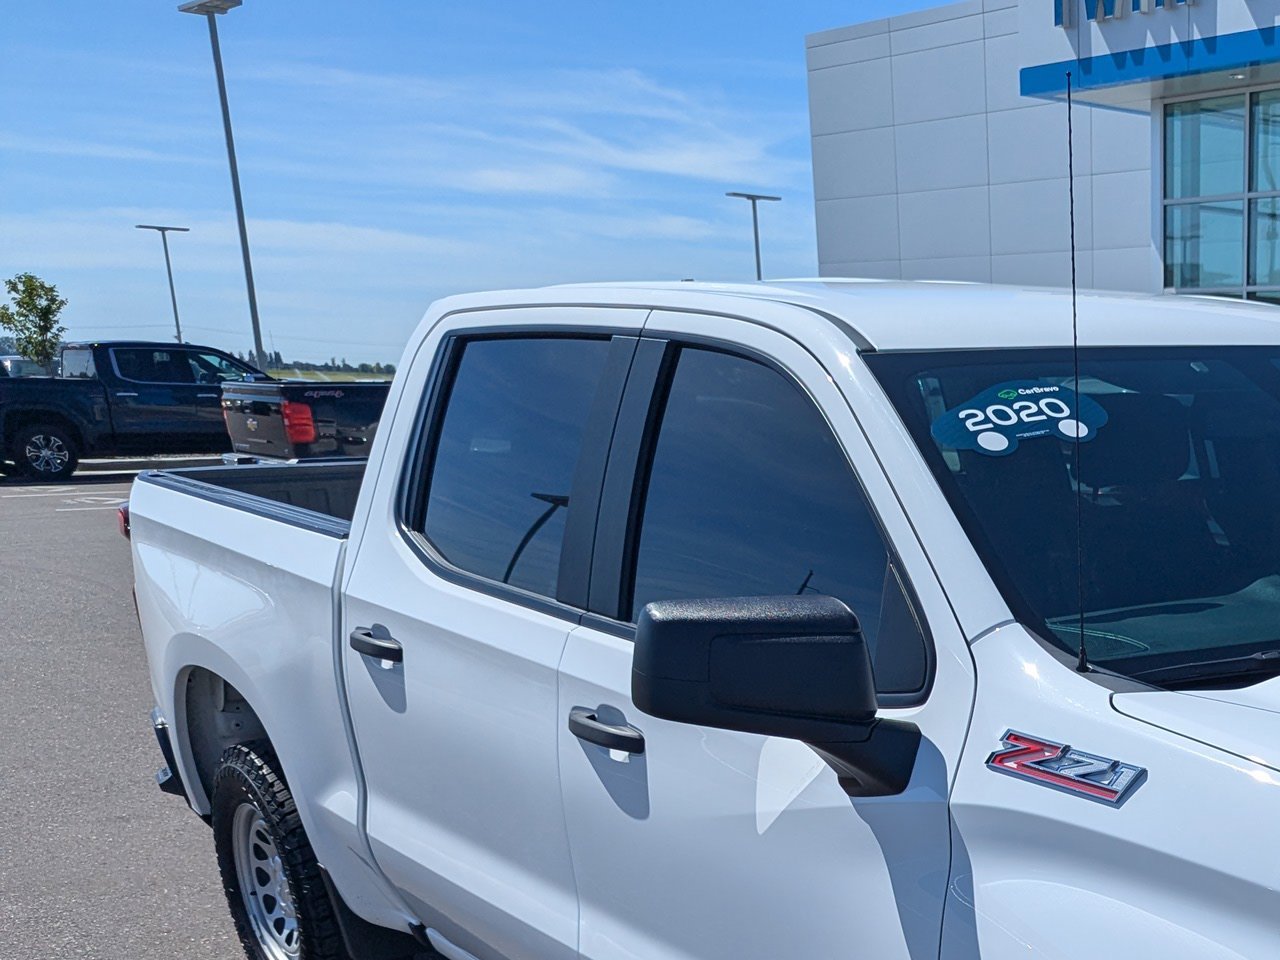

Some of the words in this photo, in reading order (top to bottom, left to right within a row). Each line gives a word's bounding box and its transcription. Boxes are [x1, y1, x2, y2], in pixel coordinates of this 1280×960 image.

[1018, 386, 1059, 395] CarBravo
[959, 398, 1071, 431] 2020
[985, 728, 1147, 809] Z71
